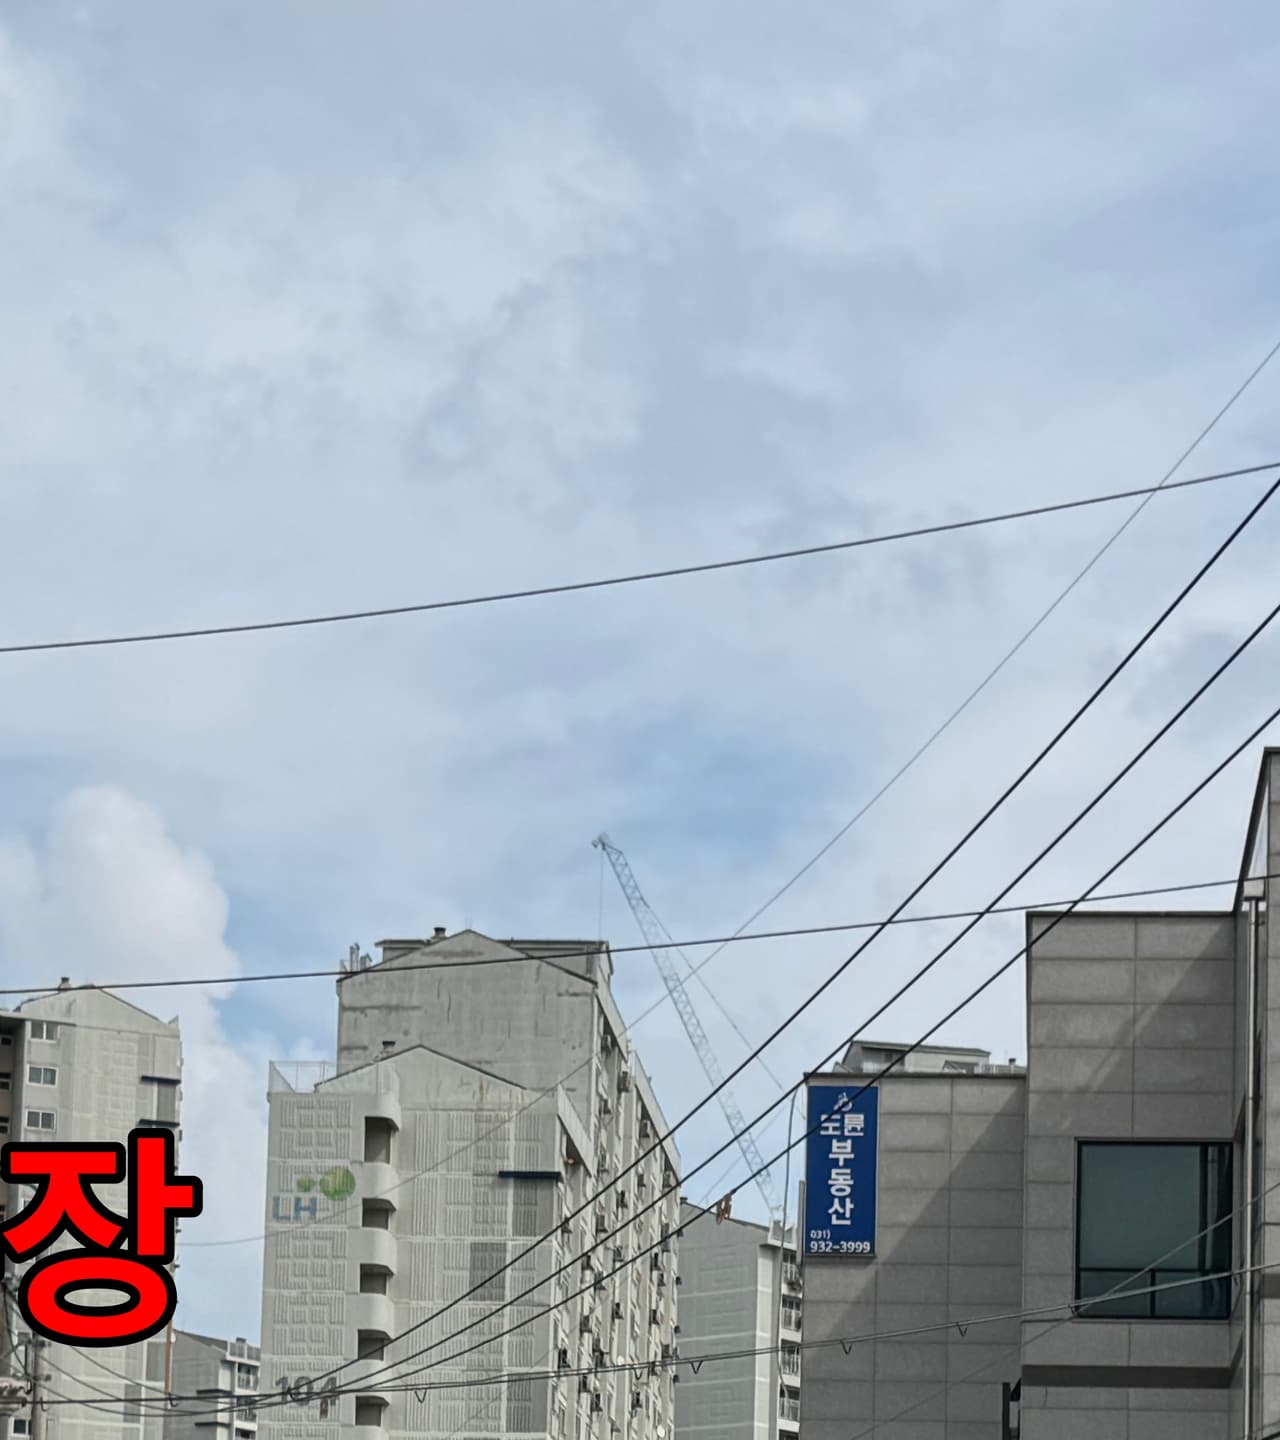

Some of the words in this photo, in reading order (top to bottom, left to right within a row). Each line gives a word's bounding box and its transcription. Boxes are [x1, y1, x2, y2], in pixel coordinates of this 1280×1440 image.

[828, 1139, 855, 1225] 부동산
[272, 1197, 317, 1223] LH
[810, 1241, 870, 1253] 932-3999
